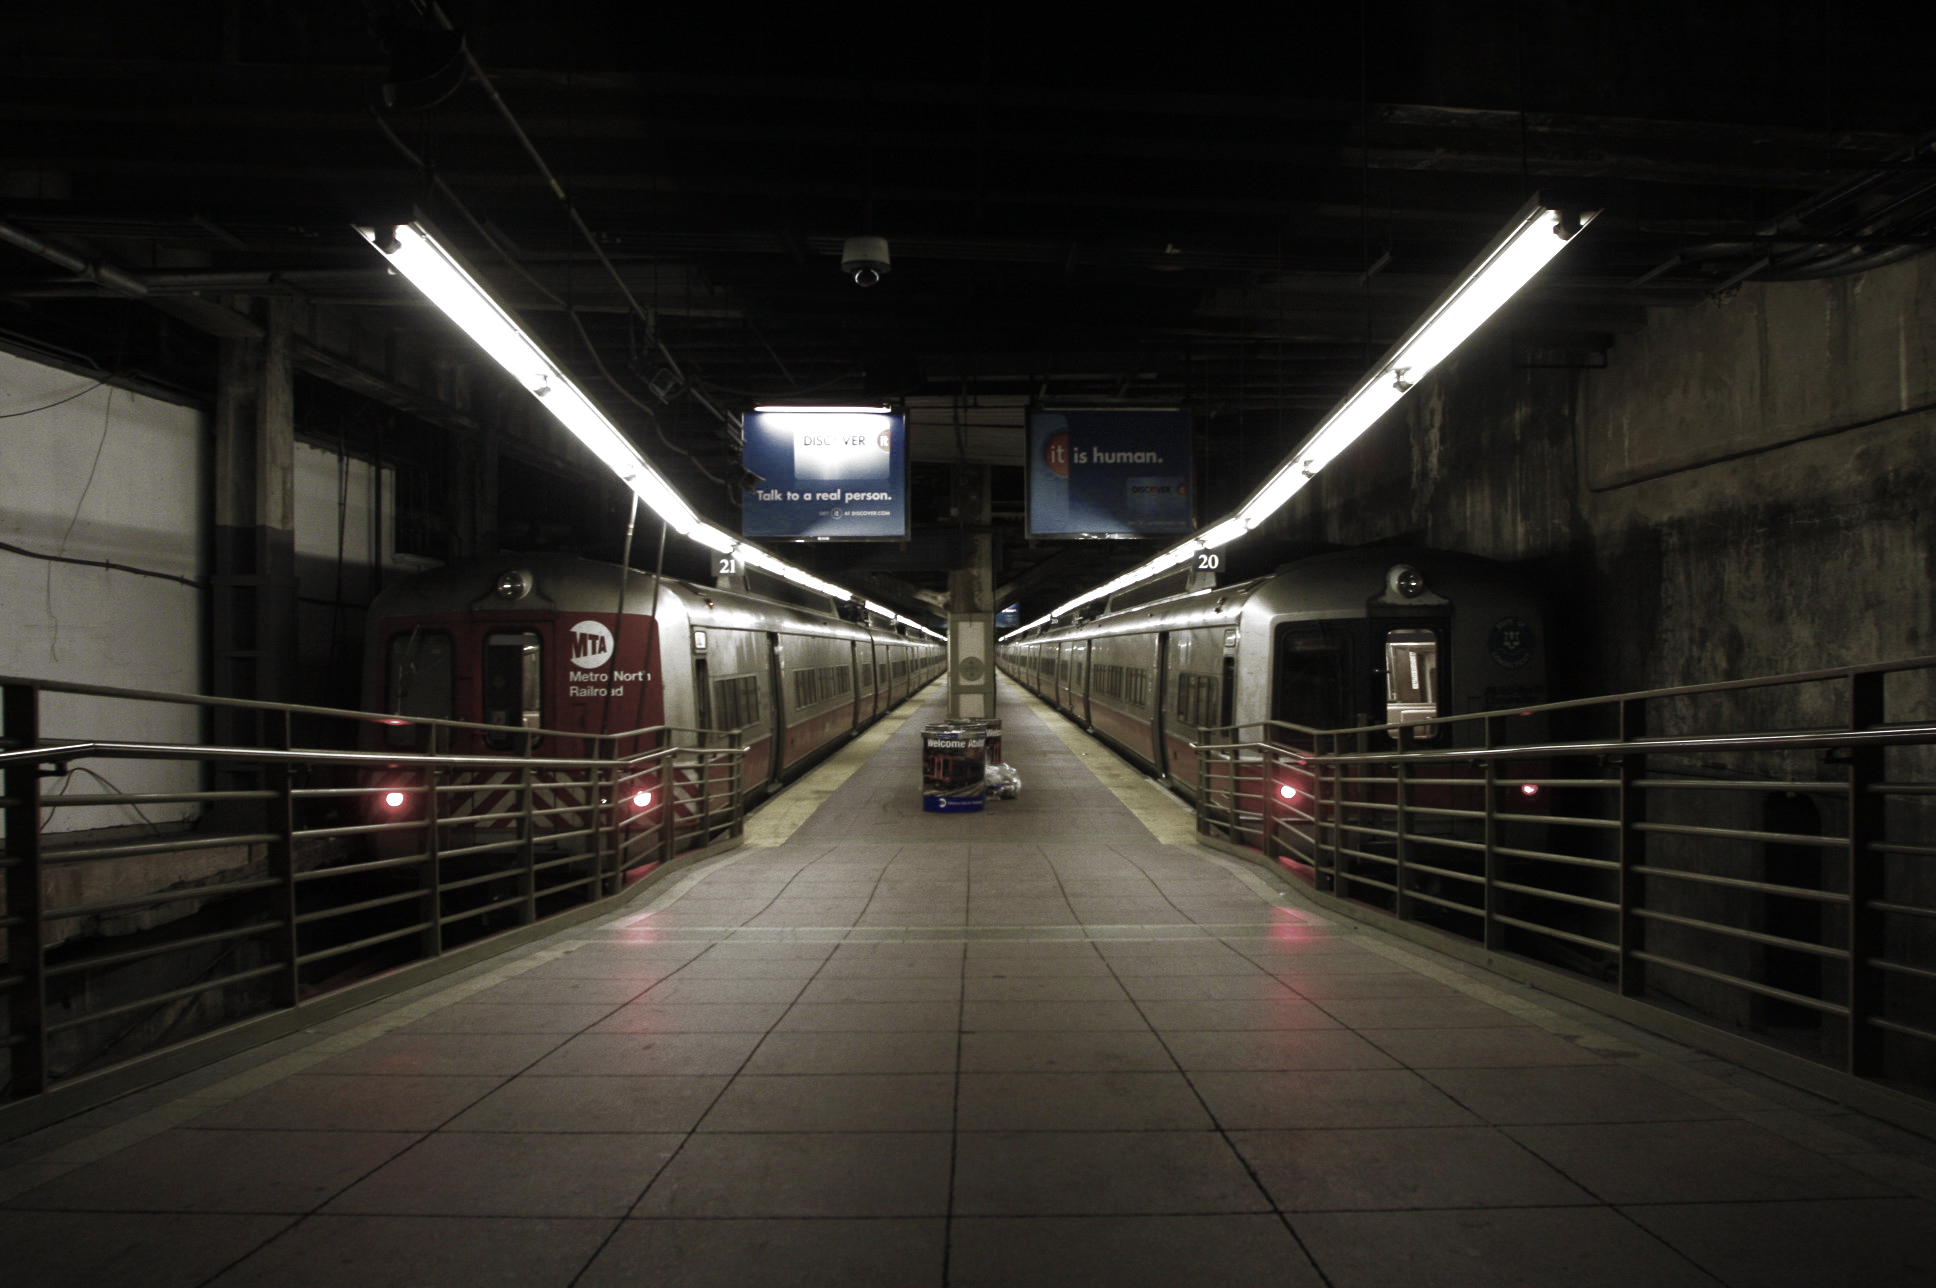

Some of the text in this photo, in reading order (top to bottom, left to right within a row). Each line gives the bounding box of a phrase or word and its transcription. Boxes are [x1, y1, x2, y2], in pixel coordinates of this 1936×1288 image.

[803, 435, 866, 447] DISCVER
[1050, 445, 1164, 464] it is human.
[756, 488, 892, 504] Talk to a real person.
[719, 558, 736, 574] 21
[1198, 554, 1219, 570] 20
[571, 630, 607, 659] MTA
[569, 671, 608, 682] Metro
[927, 739, 966, 748] Welcome
